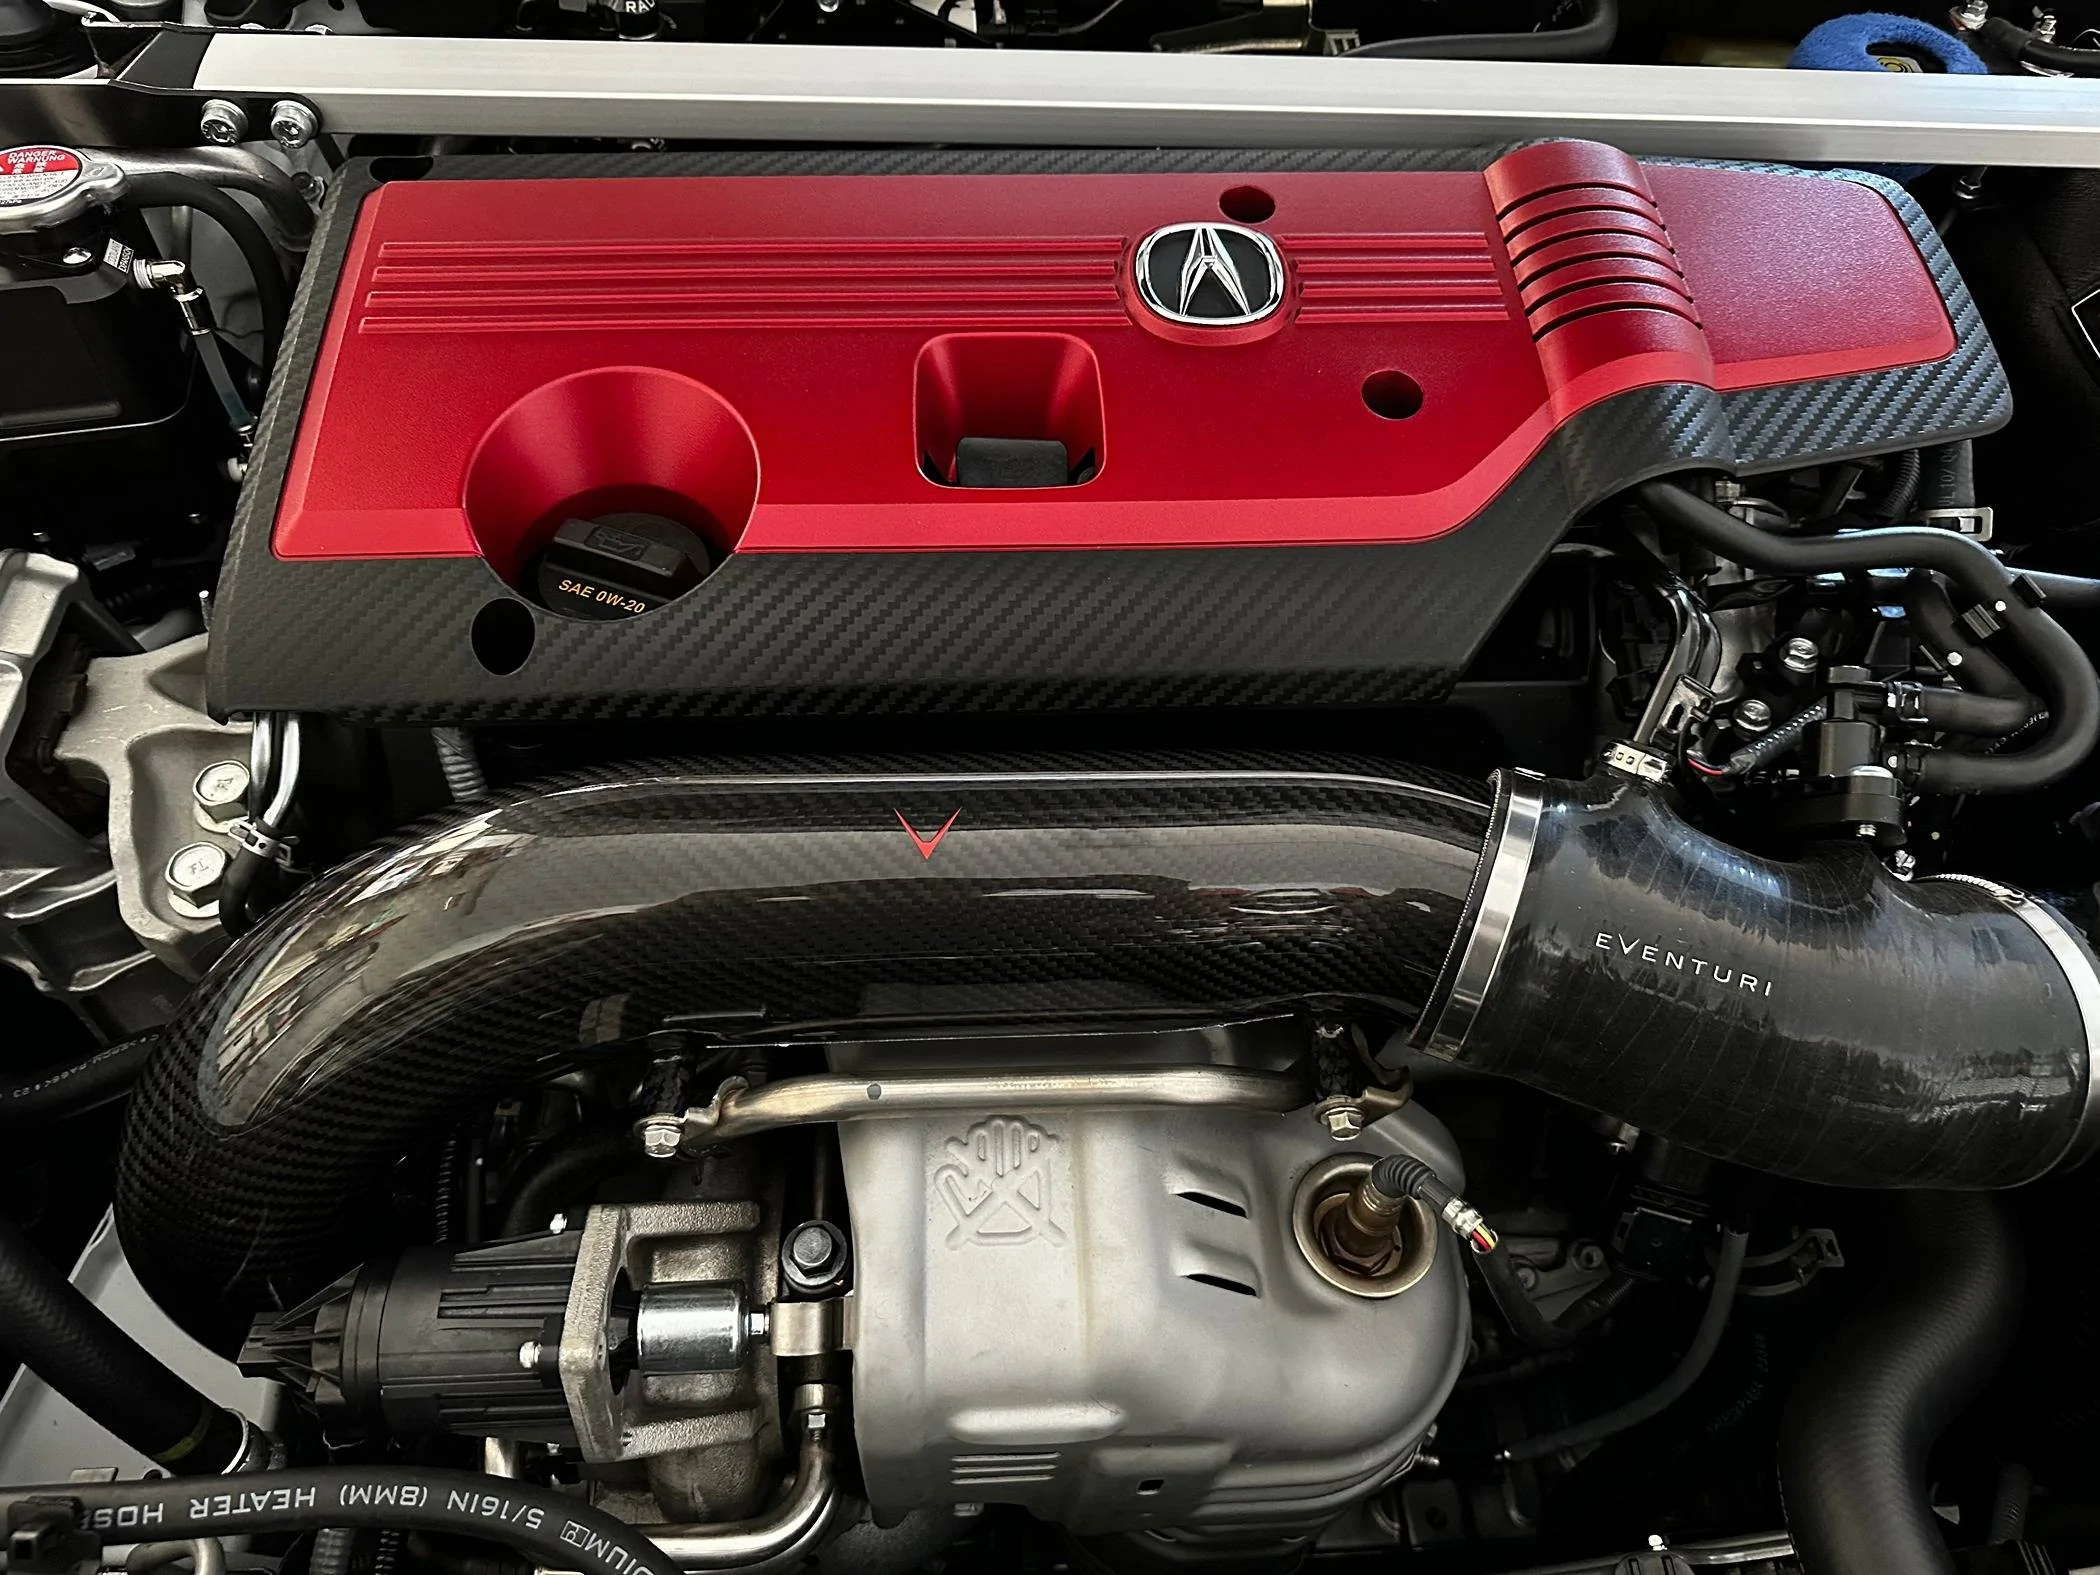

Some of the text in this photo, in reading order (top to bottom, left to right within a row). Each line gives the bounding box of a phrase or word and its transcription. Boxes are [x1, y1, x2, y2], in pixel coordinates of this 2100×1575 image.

[7, 155, 65, 164] WARNUNG
[9, 150, 57, 159] DANGER
[558, 579, 646, 614] SAE 0W-20
[1595, 932, 1772, 996] EVENTURI
[189, 1486, 316, 1519] HEATER
[339, 1484, 428, 1507] (8MM)
[446, 1489, 545, 1530] 5/16IN
